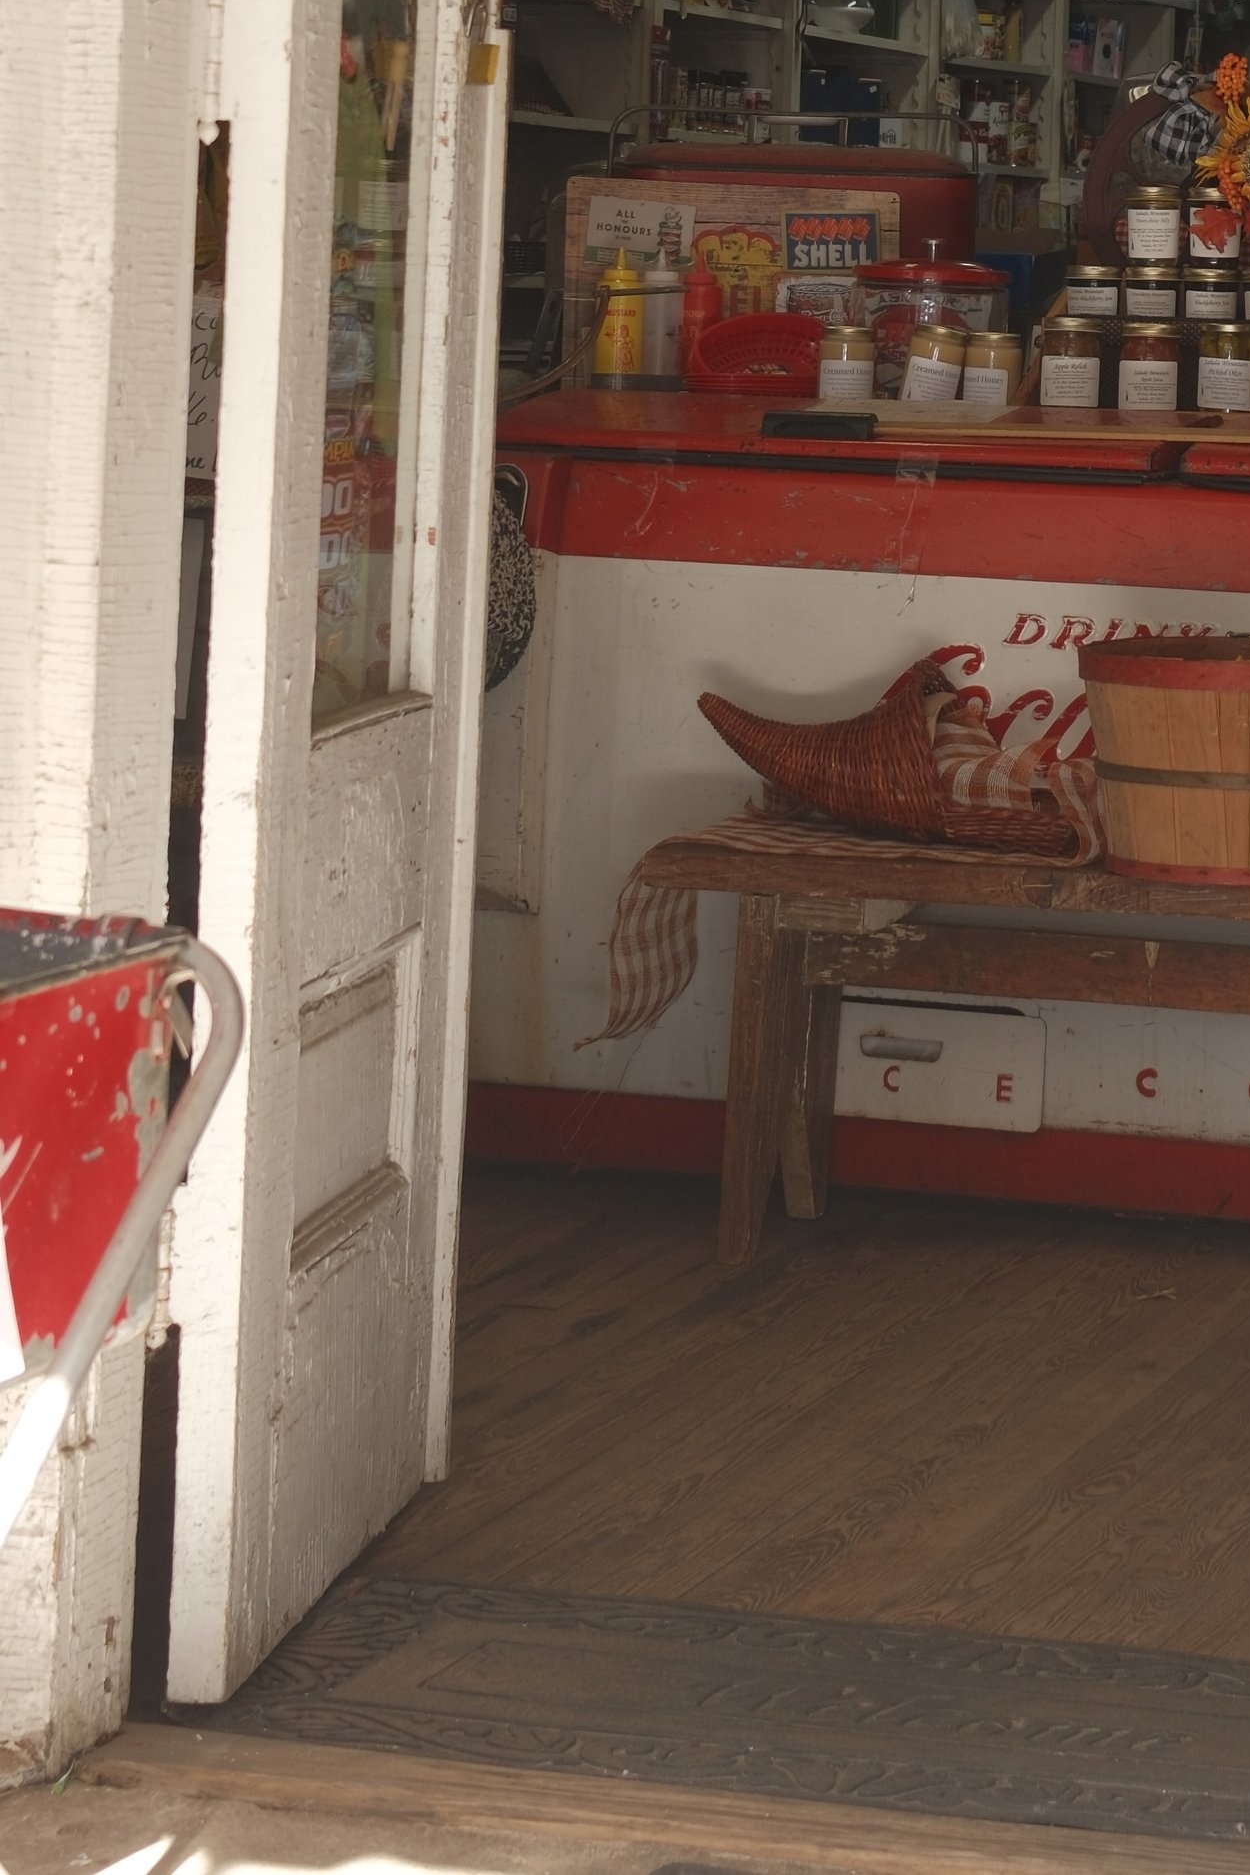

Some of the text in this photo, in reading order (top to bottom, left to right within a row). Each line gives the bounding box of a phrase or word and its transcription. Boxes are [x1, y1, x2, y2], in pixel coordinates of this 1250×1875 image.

[615, 208, 636, 220] ALL
[595, 222, 653, 237] HONOURS
[792, 240, 873, 269] SHELL
[981, 375, 1005, 385] Honey
